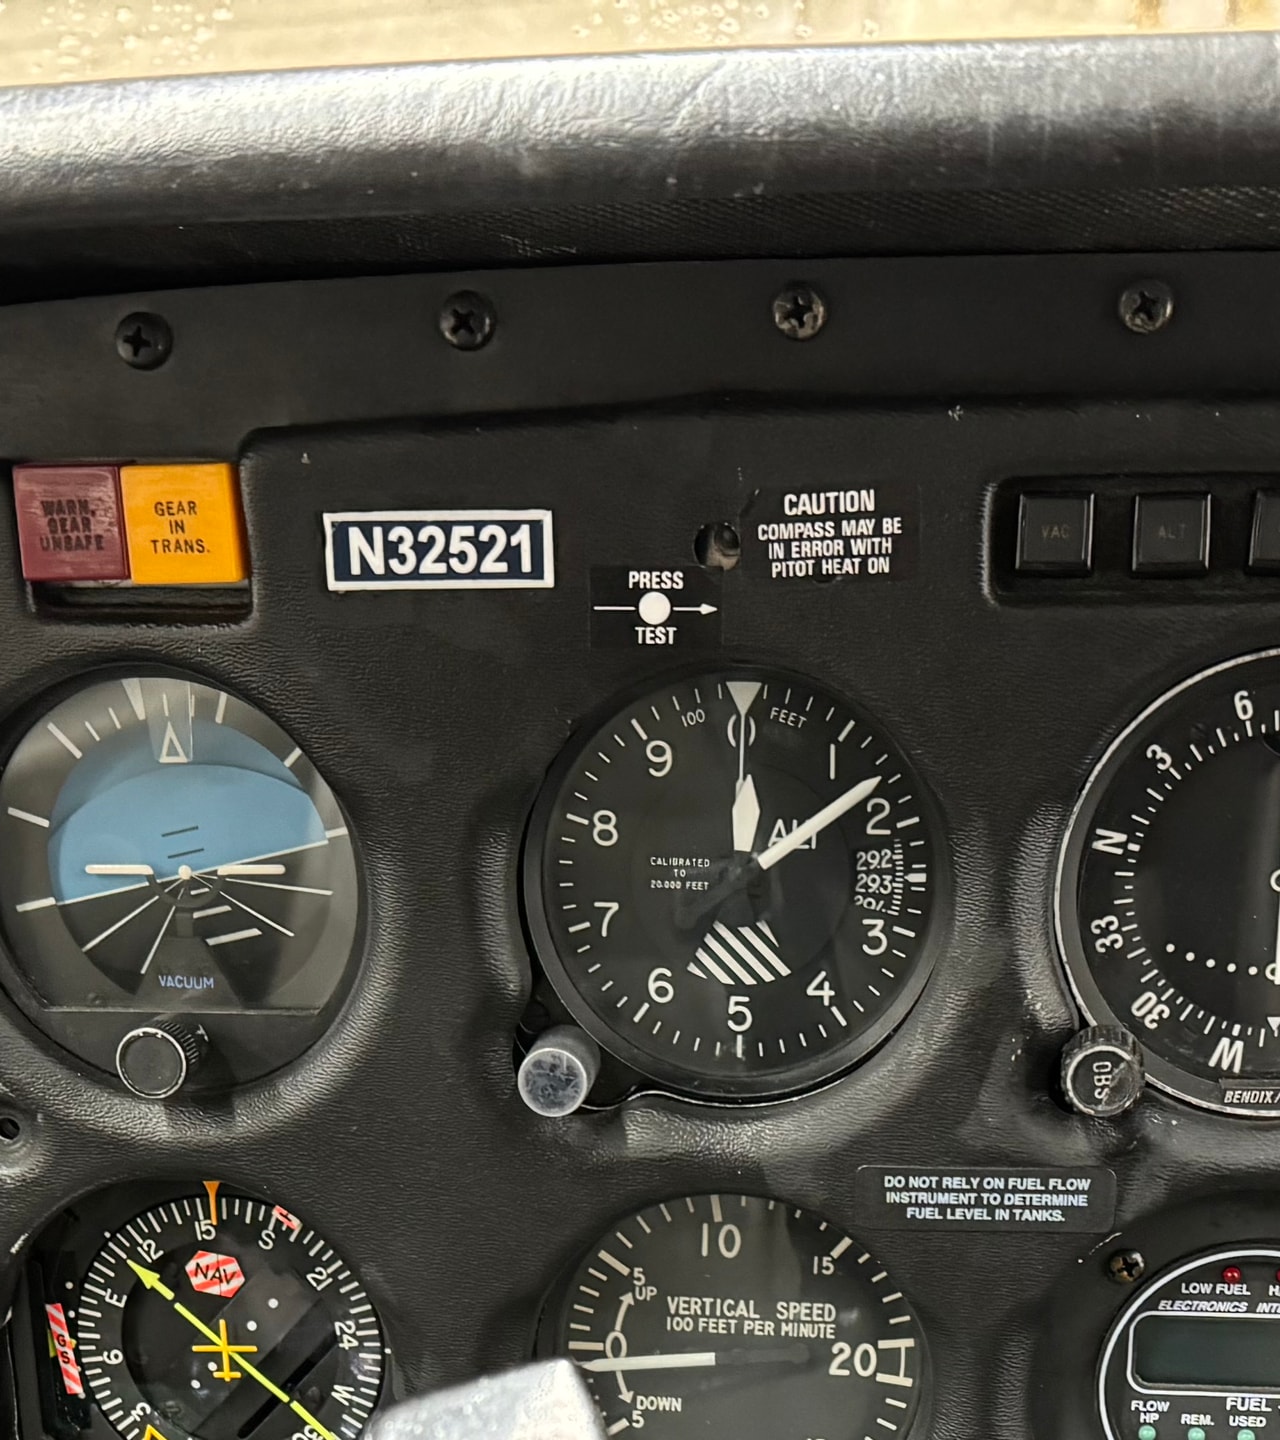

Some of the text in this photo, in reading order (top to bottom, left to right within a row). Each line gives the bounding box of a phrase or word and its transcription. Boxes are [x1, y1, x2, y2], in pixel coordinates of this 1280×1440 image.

[154, 500, 198, 517] GEAR
[783, 489, 875, 516] CAUTION
[169, 519, 186, 535] IN
[757, 517, 903, 541] COMPASS MAY BE
[150, 539, 210, 554] TRANS.
[348, 523, 534, 577] N32521
[768, 537, 892, 560] IN ERROR WITH
[771, 556, 890, 578] PITOT HEAT ON
[628, 571, 684, 590] PRESS
[634, 626, 677, 645] TEST
[158, 975, 215, 990] VACUUM
[883, 1175, 1091, 1191] DO NOT RELY ON FUEL FLOW
[886, 1191, 1089, 1207] INSTRUMENT TO DETERMINE
[906, 1208, 1065, 1222] FUEL LEVEL IN TANKS.
[634, 1286, 657, 1301] UP
[1180, 1283, 1252, 1296] LOW FUEL
[666, 1296, 836, 1322] VERTICAL SPEED
[666, 1317, 836, 1339] 100 FEET PER MINUTE
[636, 1395, 682, 1412] DOWN
